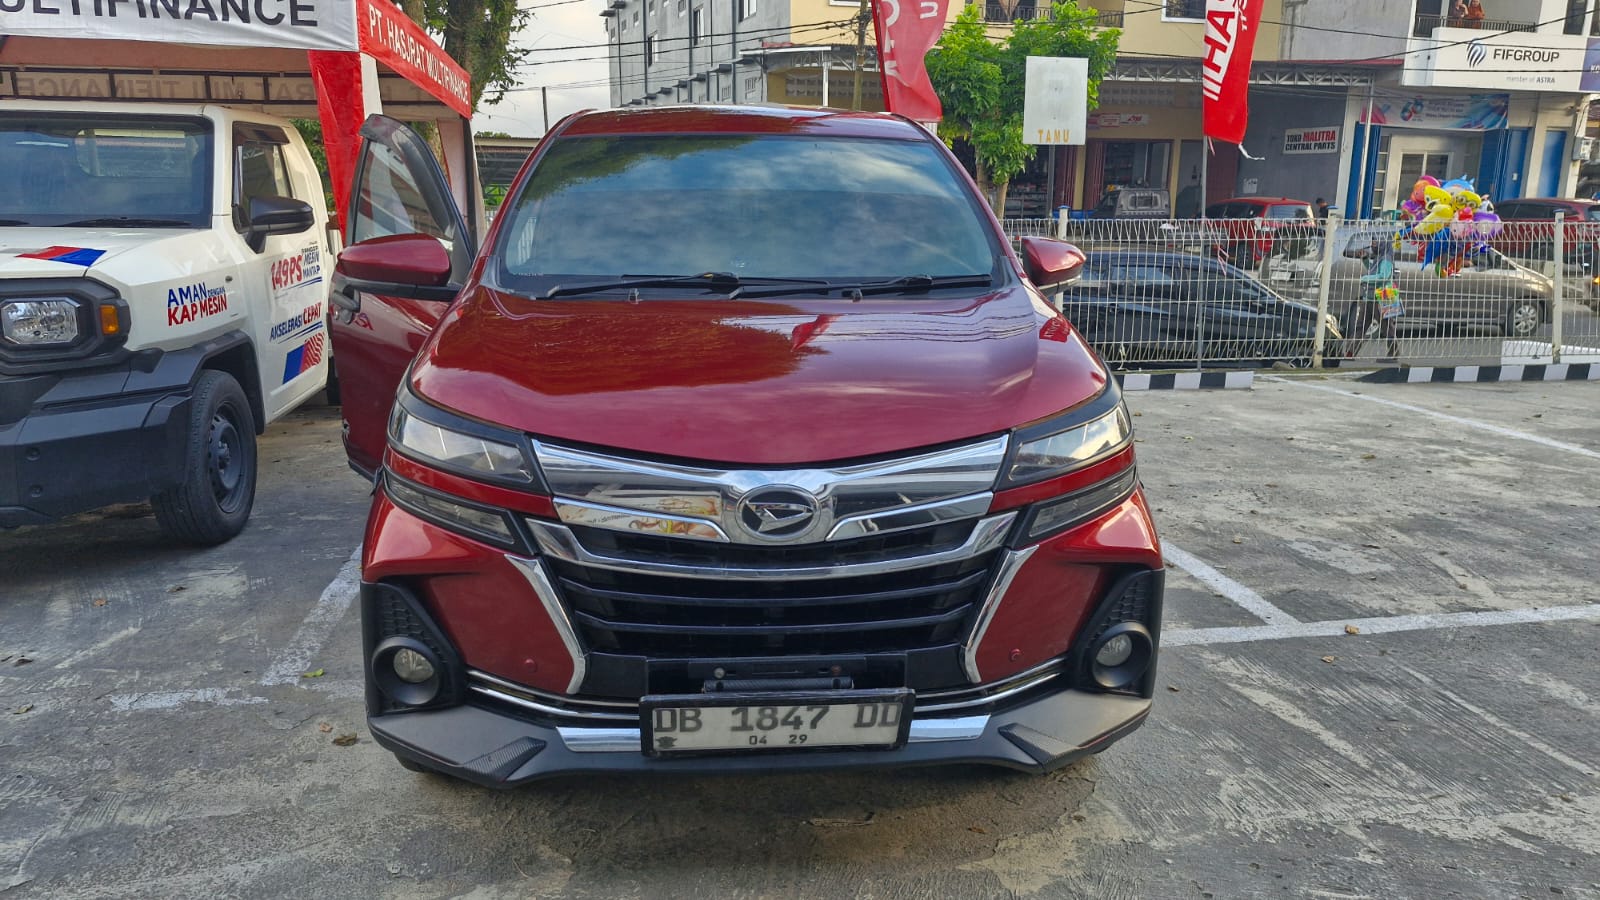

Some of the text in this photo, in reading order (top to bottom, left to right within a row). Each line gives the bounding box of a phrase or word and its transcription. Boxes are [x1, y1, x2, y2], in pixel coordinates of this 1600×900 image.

[386, 17, 426, 73] HASJRAT
[1493, 48, 1560, 62] FIFGROUP
[1536, 76, 1556, 84] ASTRA
[1038, 129, 1070, 143] TAMU
[1287, 130, 1336, 143] TOKO MALITRA
[1285, 141, 1336, 151] CENTRAL PARTS
[168, 281, 207, 308] AMAN
[168, 293, 228, 327] KAP MESIN
[270, 301, 322, 342] AKSELERASI CEPAT
[653, 702, 901, 733] DB 1847 DD
[749, 734, 808, 745] 04 29
